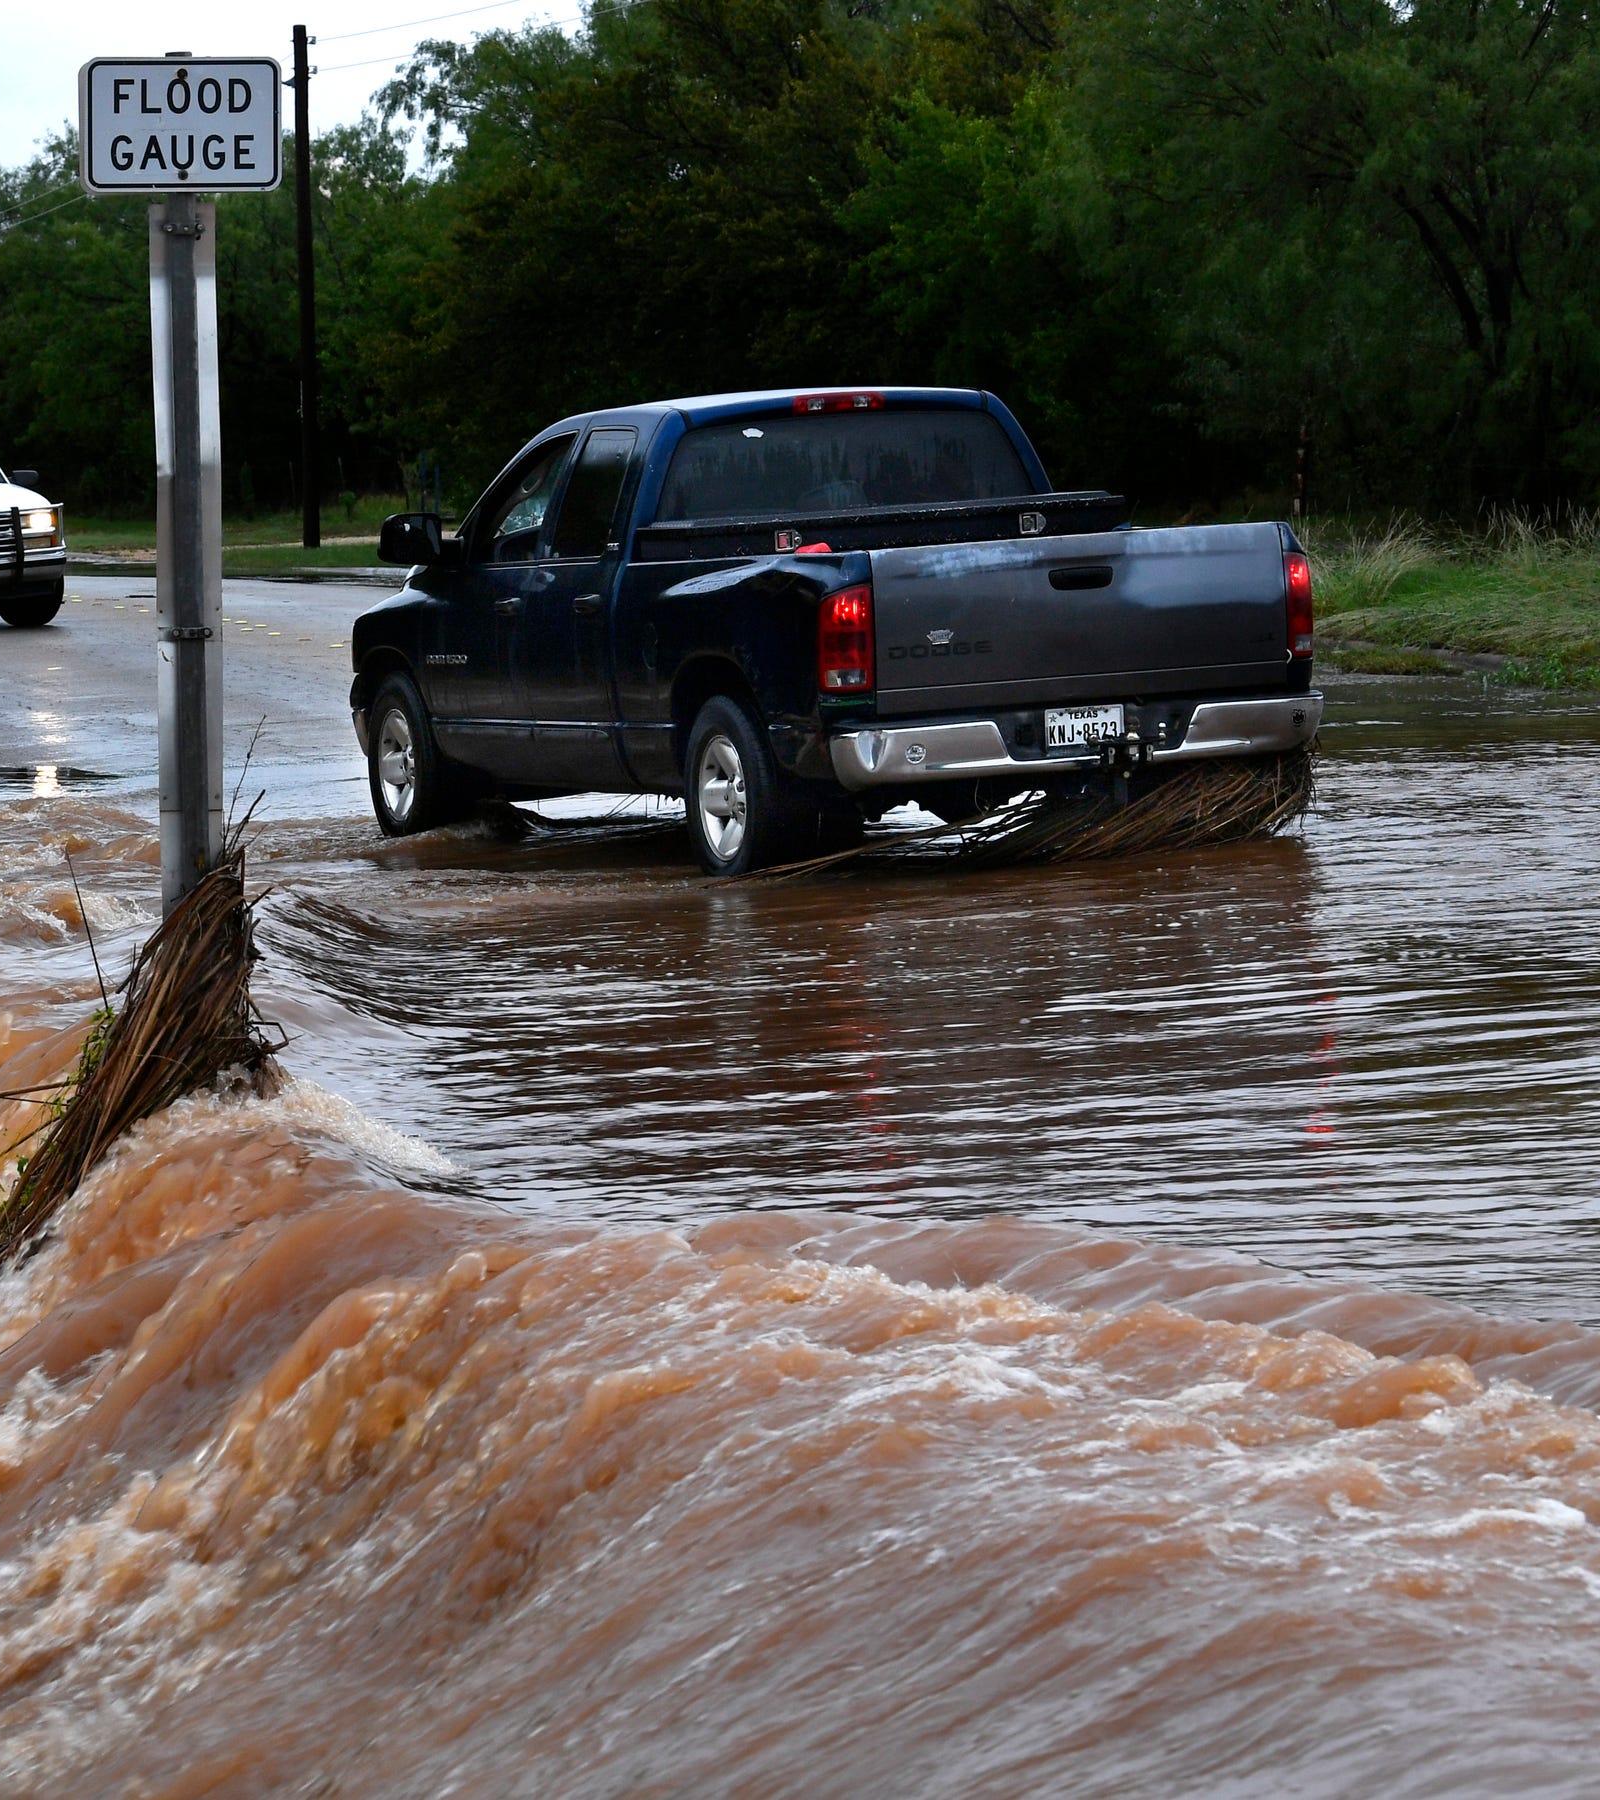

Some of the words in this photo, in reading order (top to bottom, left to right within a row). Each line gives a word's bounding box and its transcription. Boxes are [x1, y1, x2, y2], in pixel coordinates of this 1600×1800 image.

[113, 78, 252, 114] FLOOD
[111, 134, 255, 171] GAUGE
[888, 640, 993, 659] DODGE
[1069, 710, 1098, 720] TEXAS
